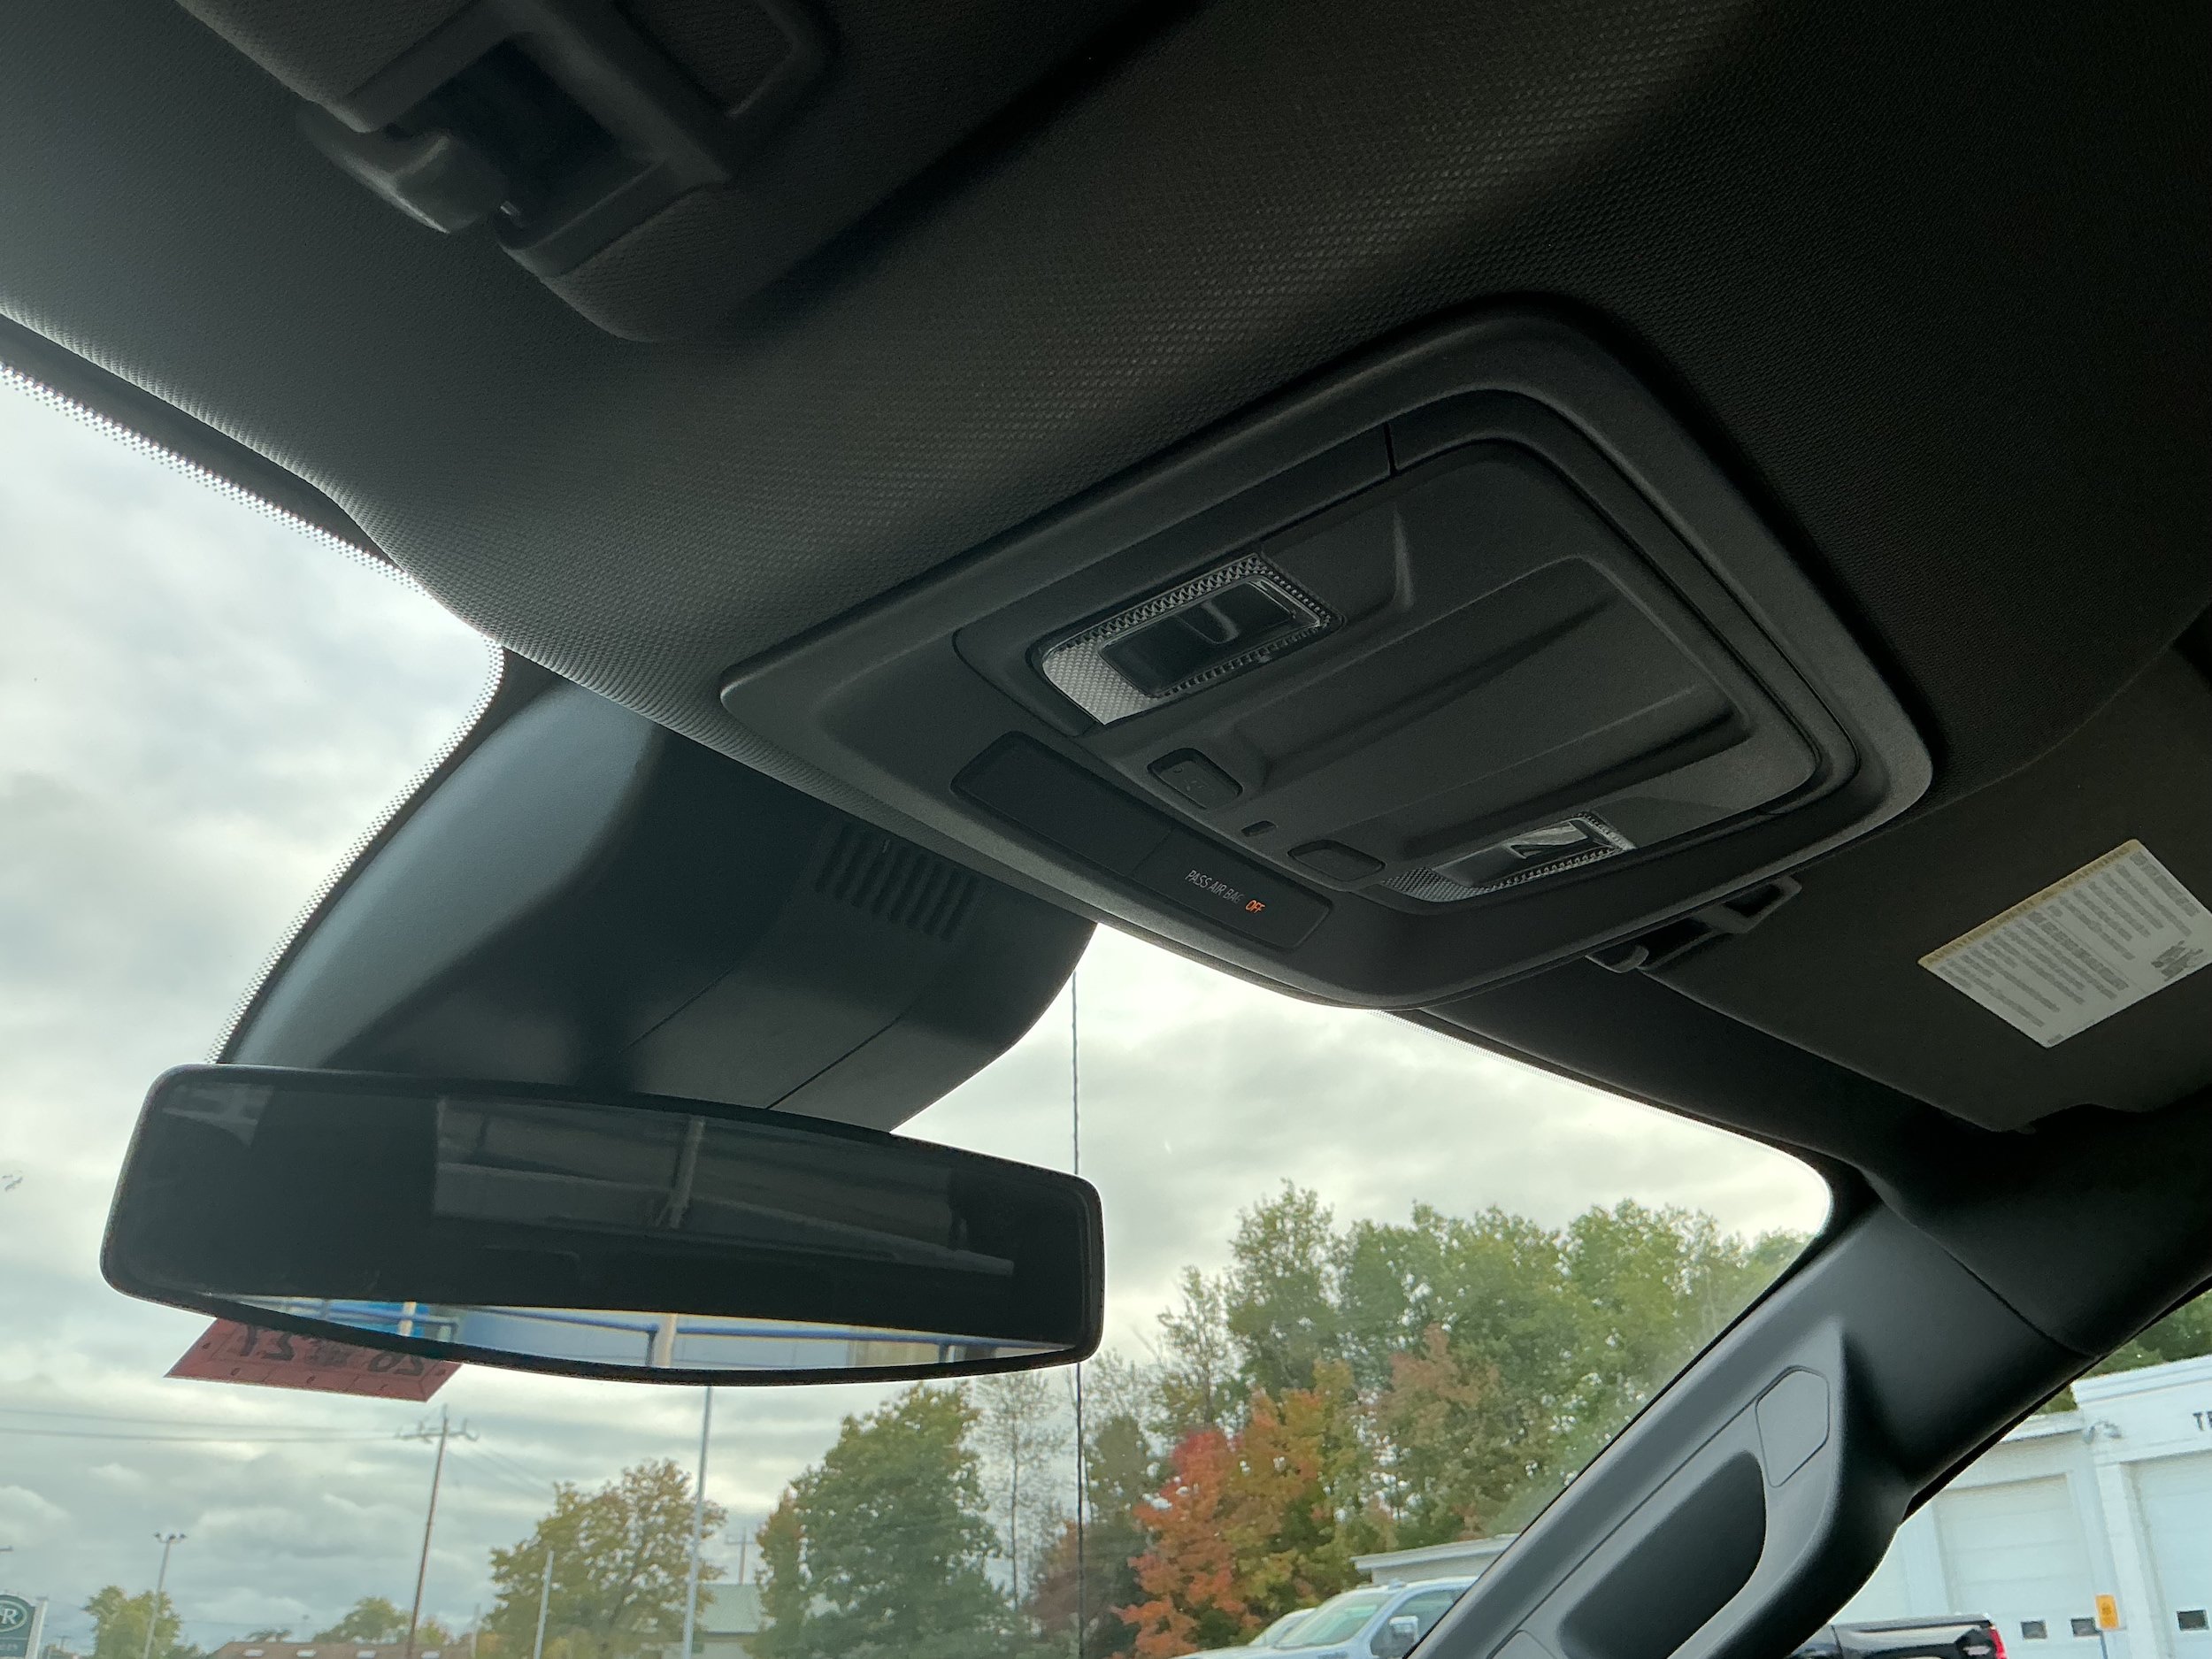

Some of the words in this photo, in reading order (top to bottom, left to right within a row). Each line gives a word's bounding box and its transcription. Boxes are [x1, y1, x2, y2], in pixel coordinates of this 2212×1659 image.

[1185, 870, 1212, 888] PASS
[1207, 881, 1227, 896] AIR
[1223, 888, 1245, 903] BAG
[1245, 899, 1265, 914] OFF
